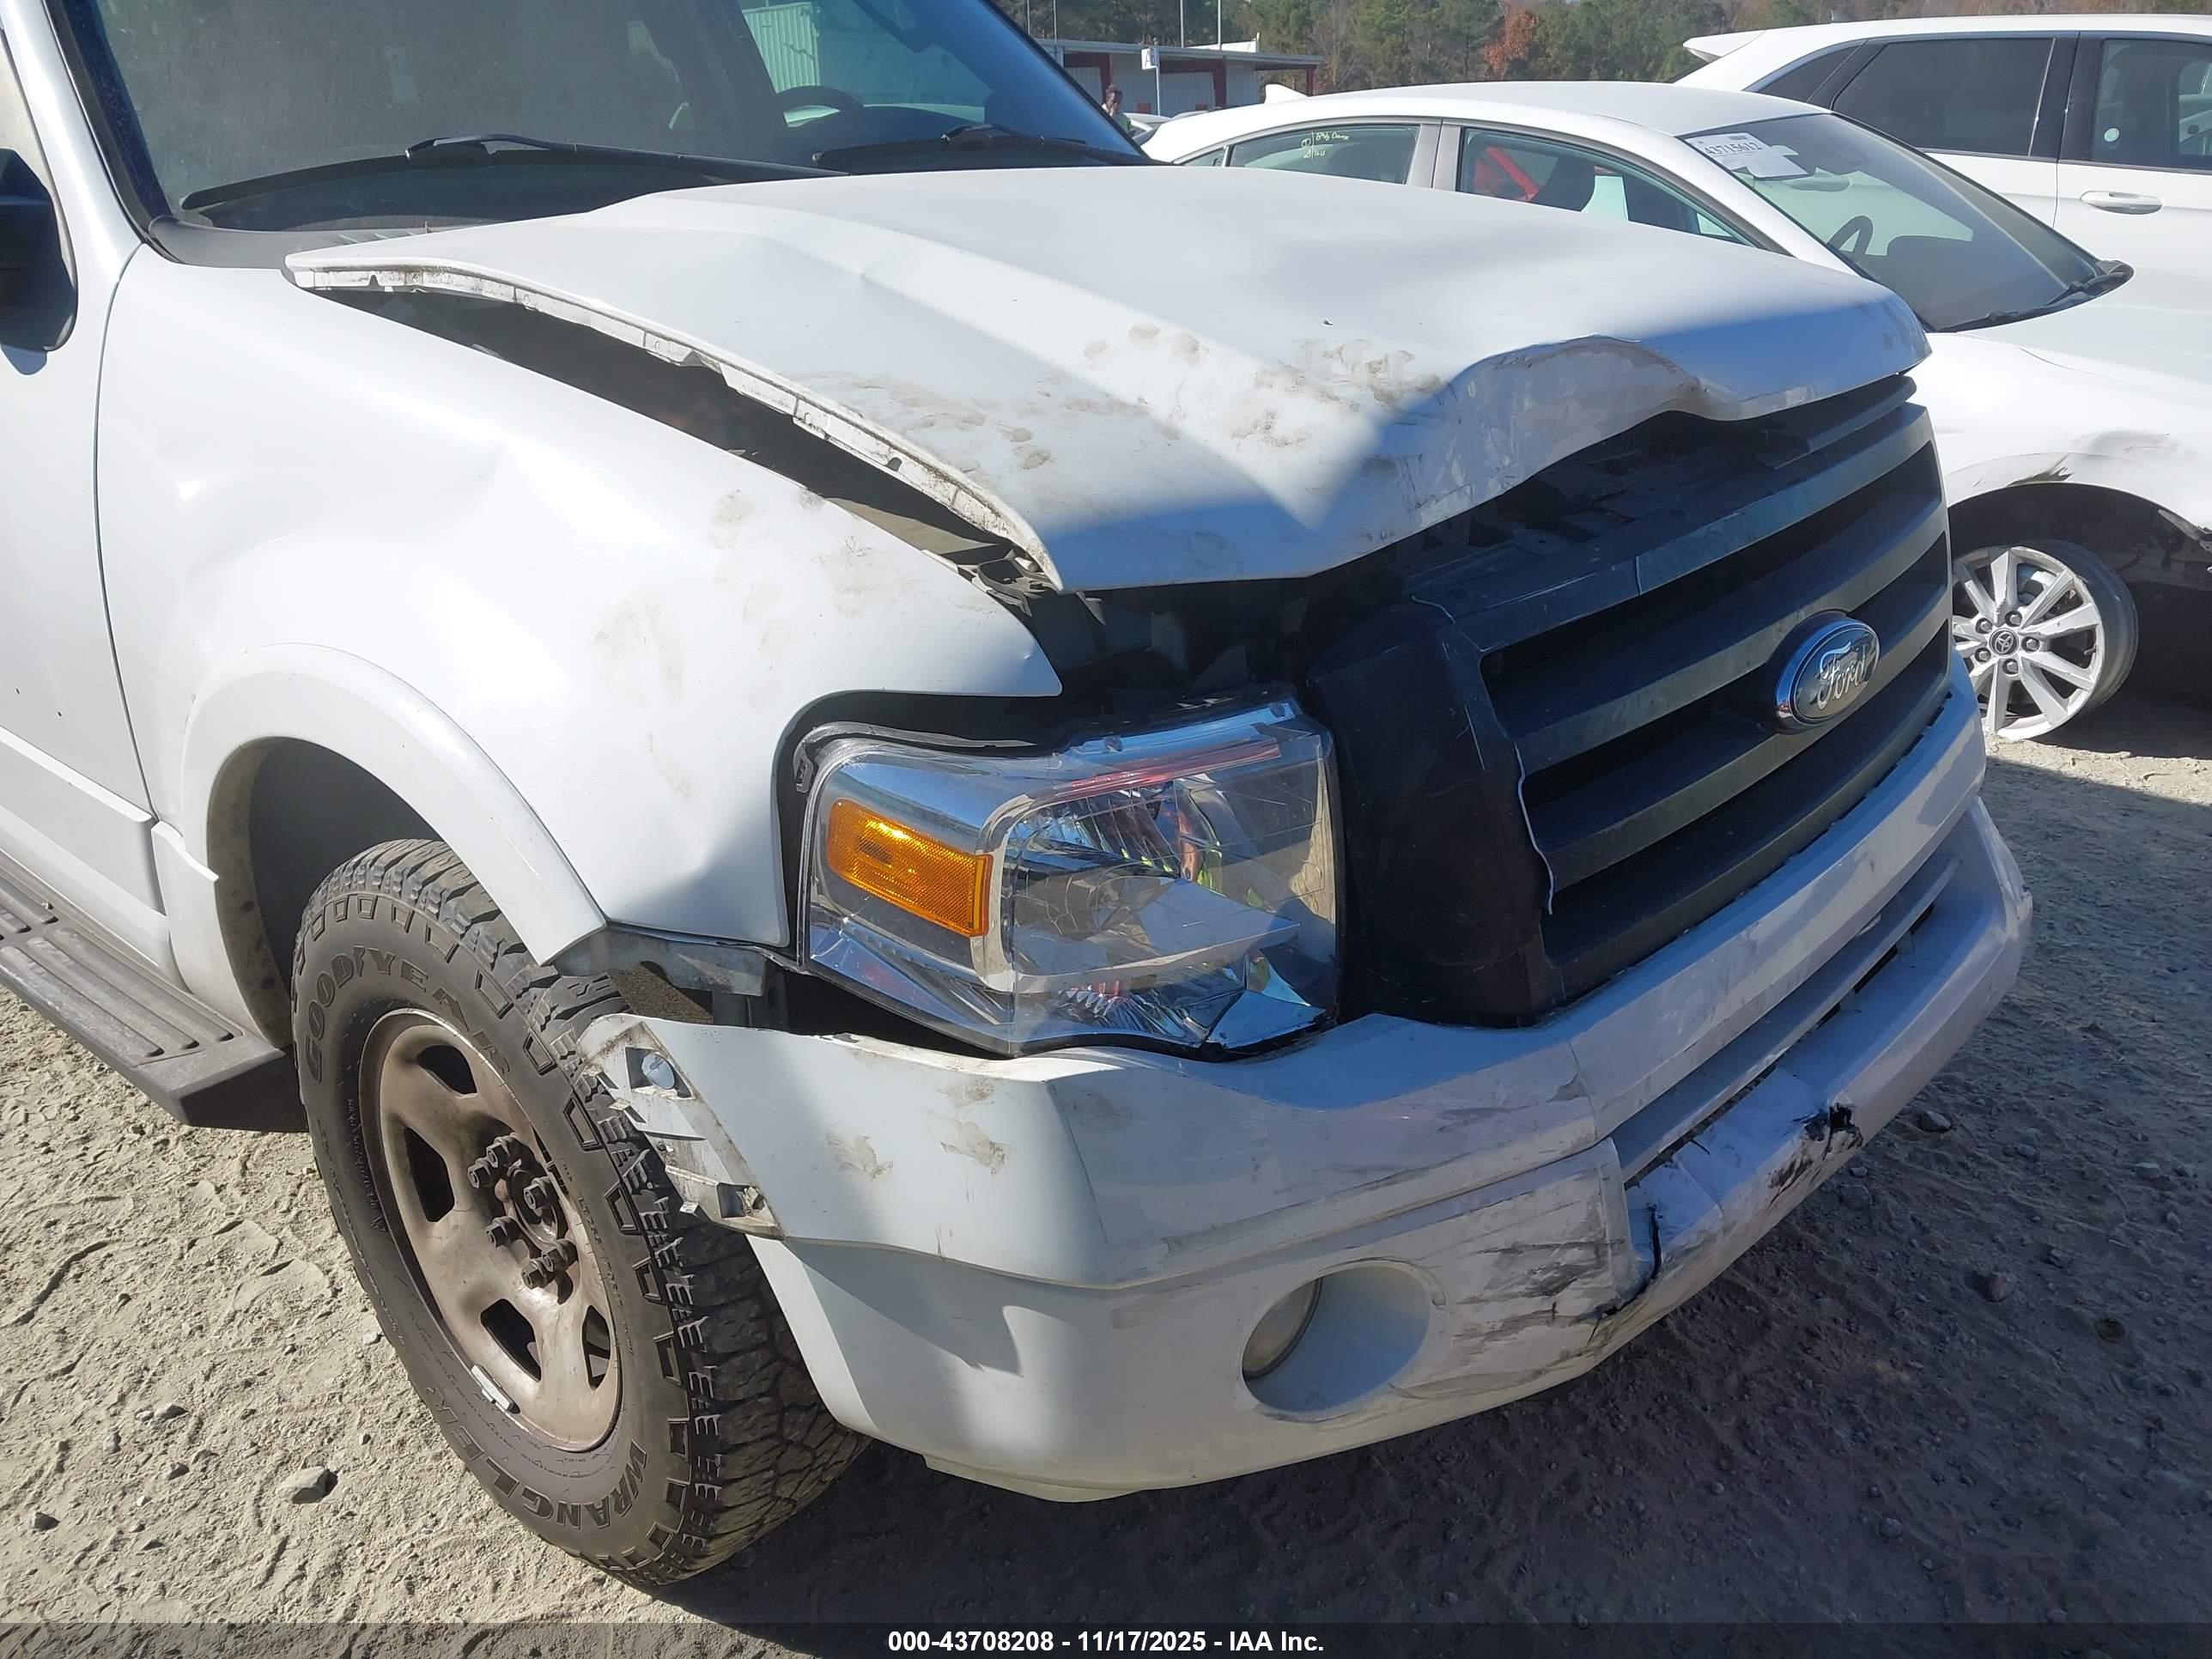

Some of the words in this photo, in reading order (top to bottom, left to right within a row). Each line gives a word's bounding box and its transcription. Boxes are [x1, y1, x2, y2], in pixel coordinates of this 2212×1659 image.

[1705, 142, 1763, 155] 43715612
[1817, 641, 1867, 710] Ford
[306, 945, 511, 1084] GOODYEAR
[425, 1386, 647, 1531] WRANGLER
